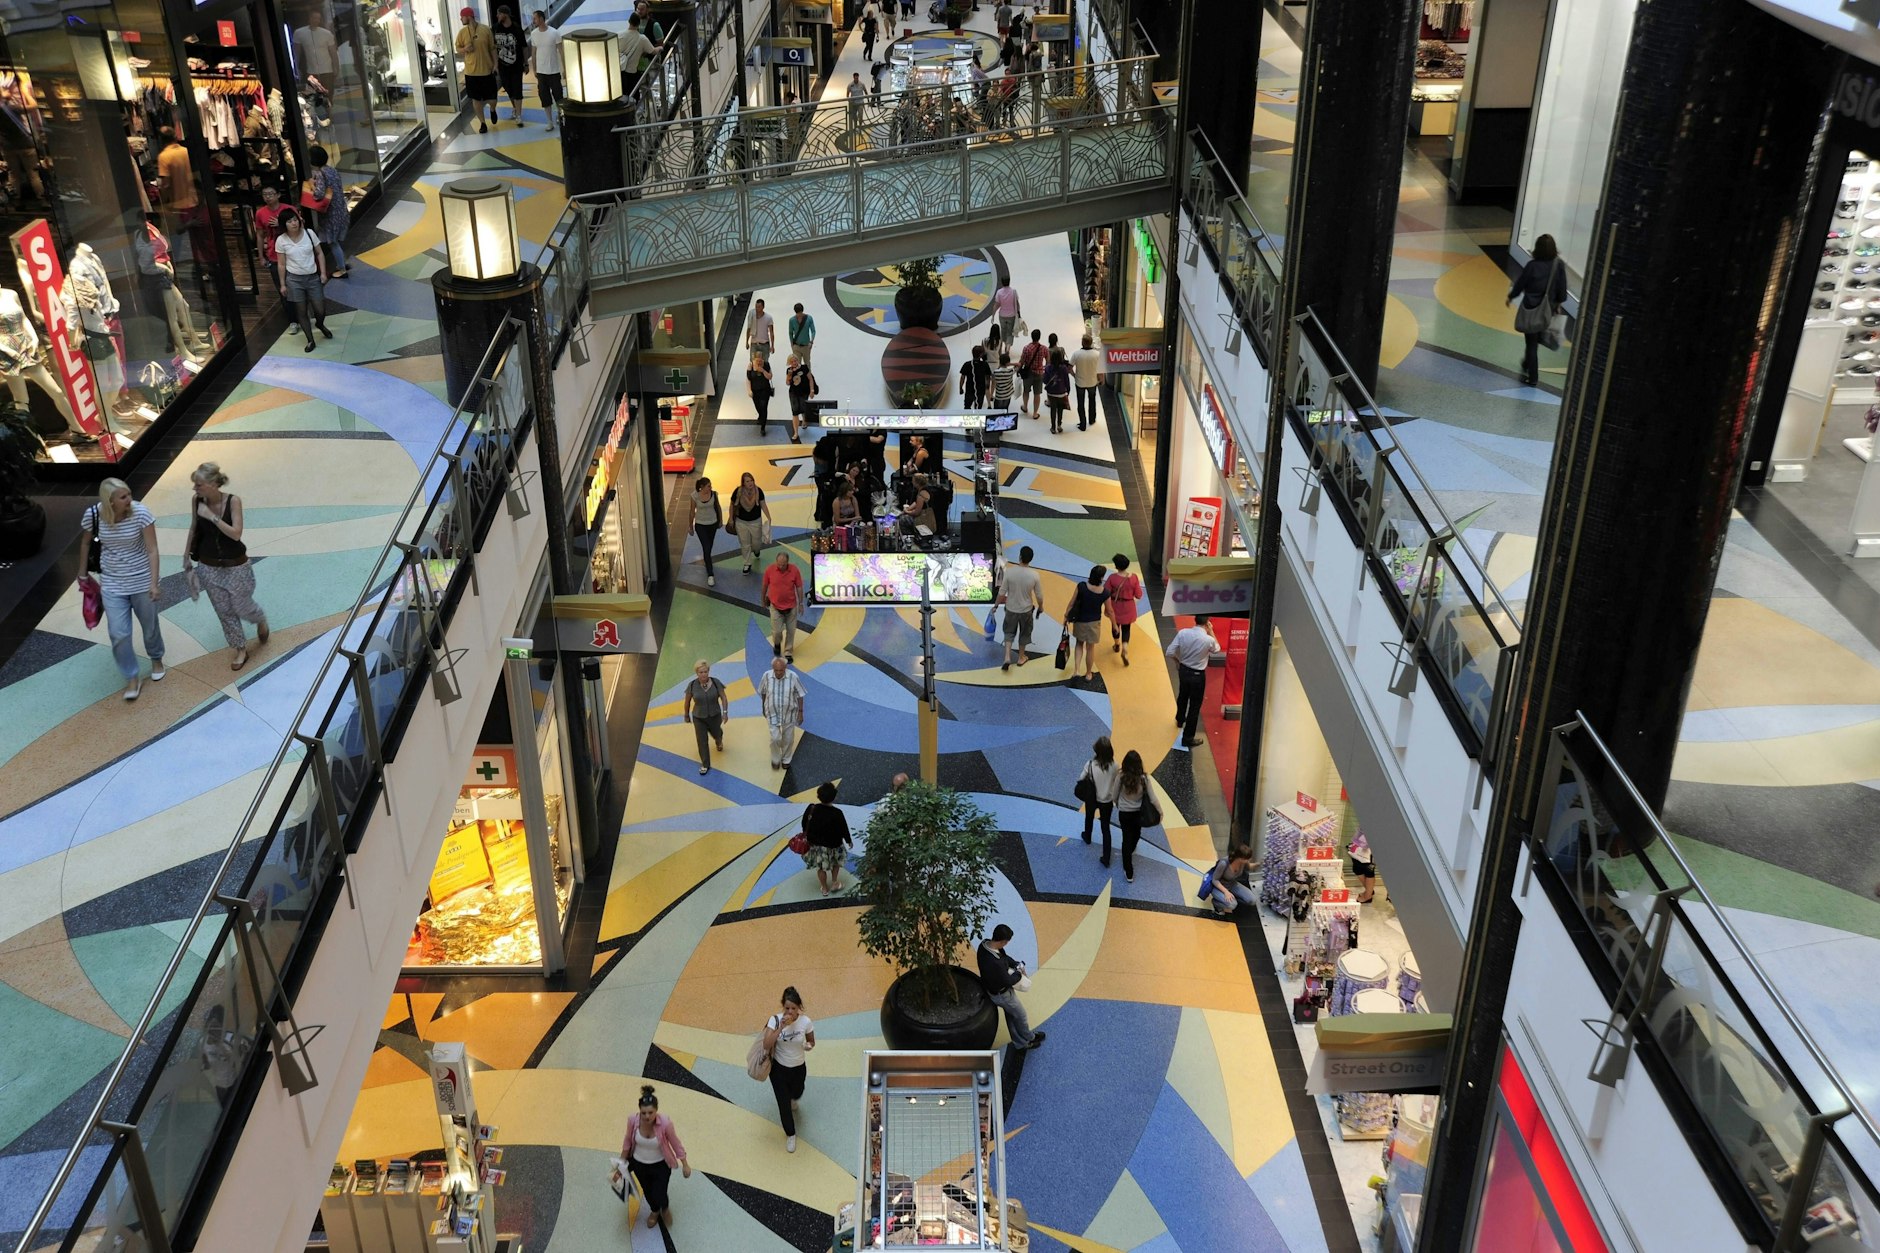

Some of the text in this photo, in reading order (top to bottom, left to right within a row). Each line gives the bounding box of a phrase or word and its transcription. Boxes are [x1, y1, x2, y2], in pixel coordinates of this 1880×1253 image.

[30, 236, 97, 422] SALE
[1109, 350, 1159, 362] Weltbild
[1172, 585, 1246, 603] claire's
[1330, 1061, 1426, 1075] Street One
